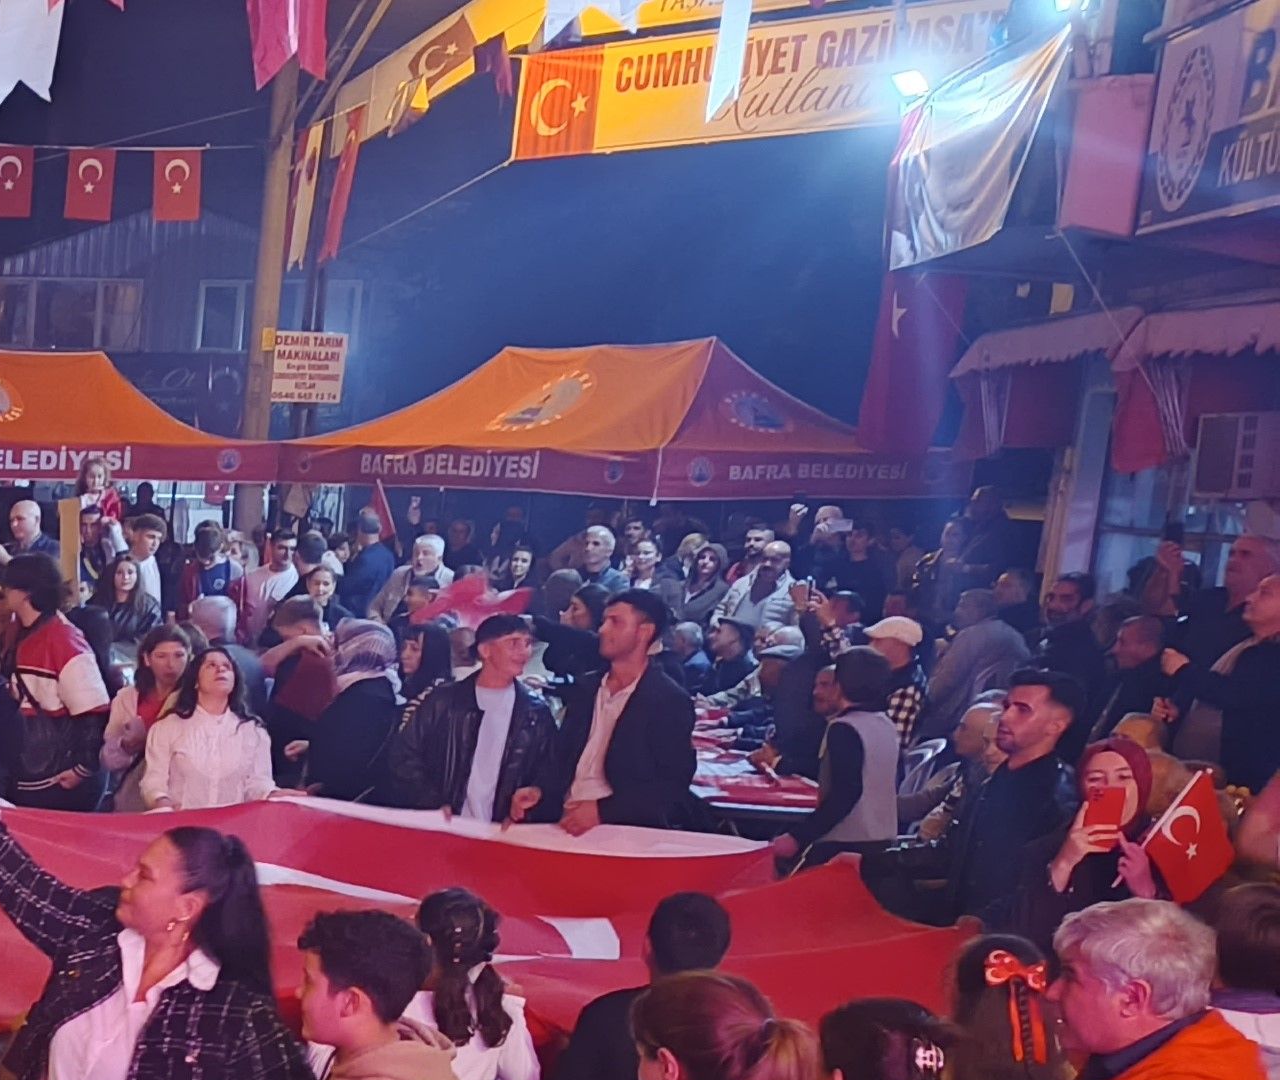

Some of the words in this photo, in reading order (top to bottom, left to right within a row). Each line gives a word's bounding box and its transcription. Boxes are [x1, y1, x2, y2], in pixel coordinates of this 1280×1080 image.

[615, 34, 807, 93] CUMHUİYET
[360, 453, 417, 475] BAFRA
[422, 449, 540, 479] BELEDİYESİ
[728, 463, 791, 481] BAFRA
[797, 461, 909, 480] BELEDİYESİ
